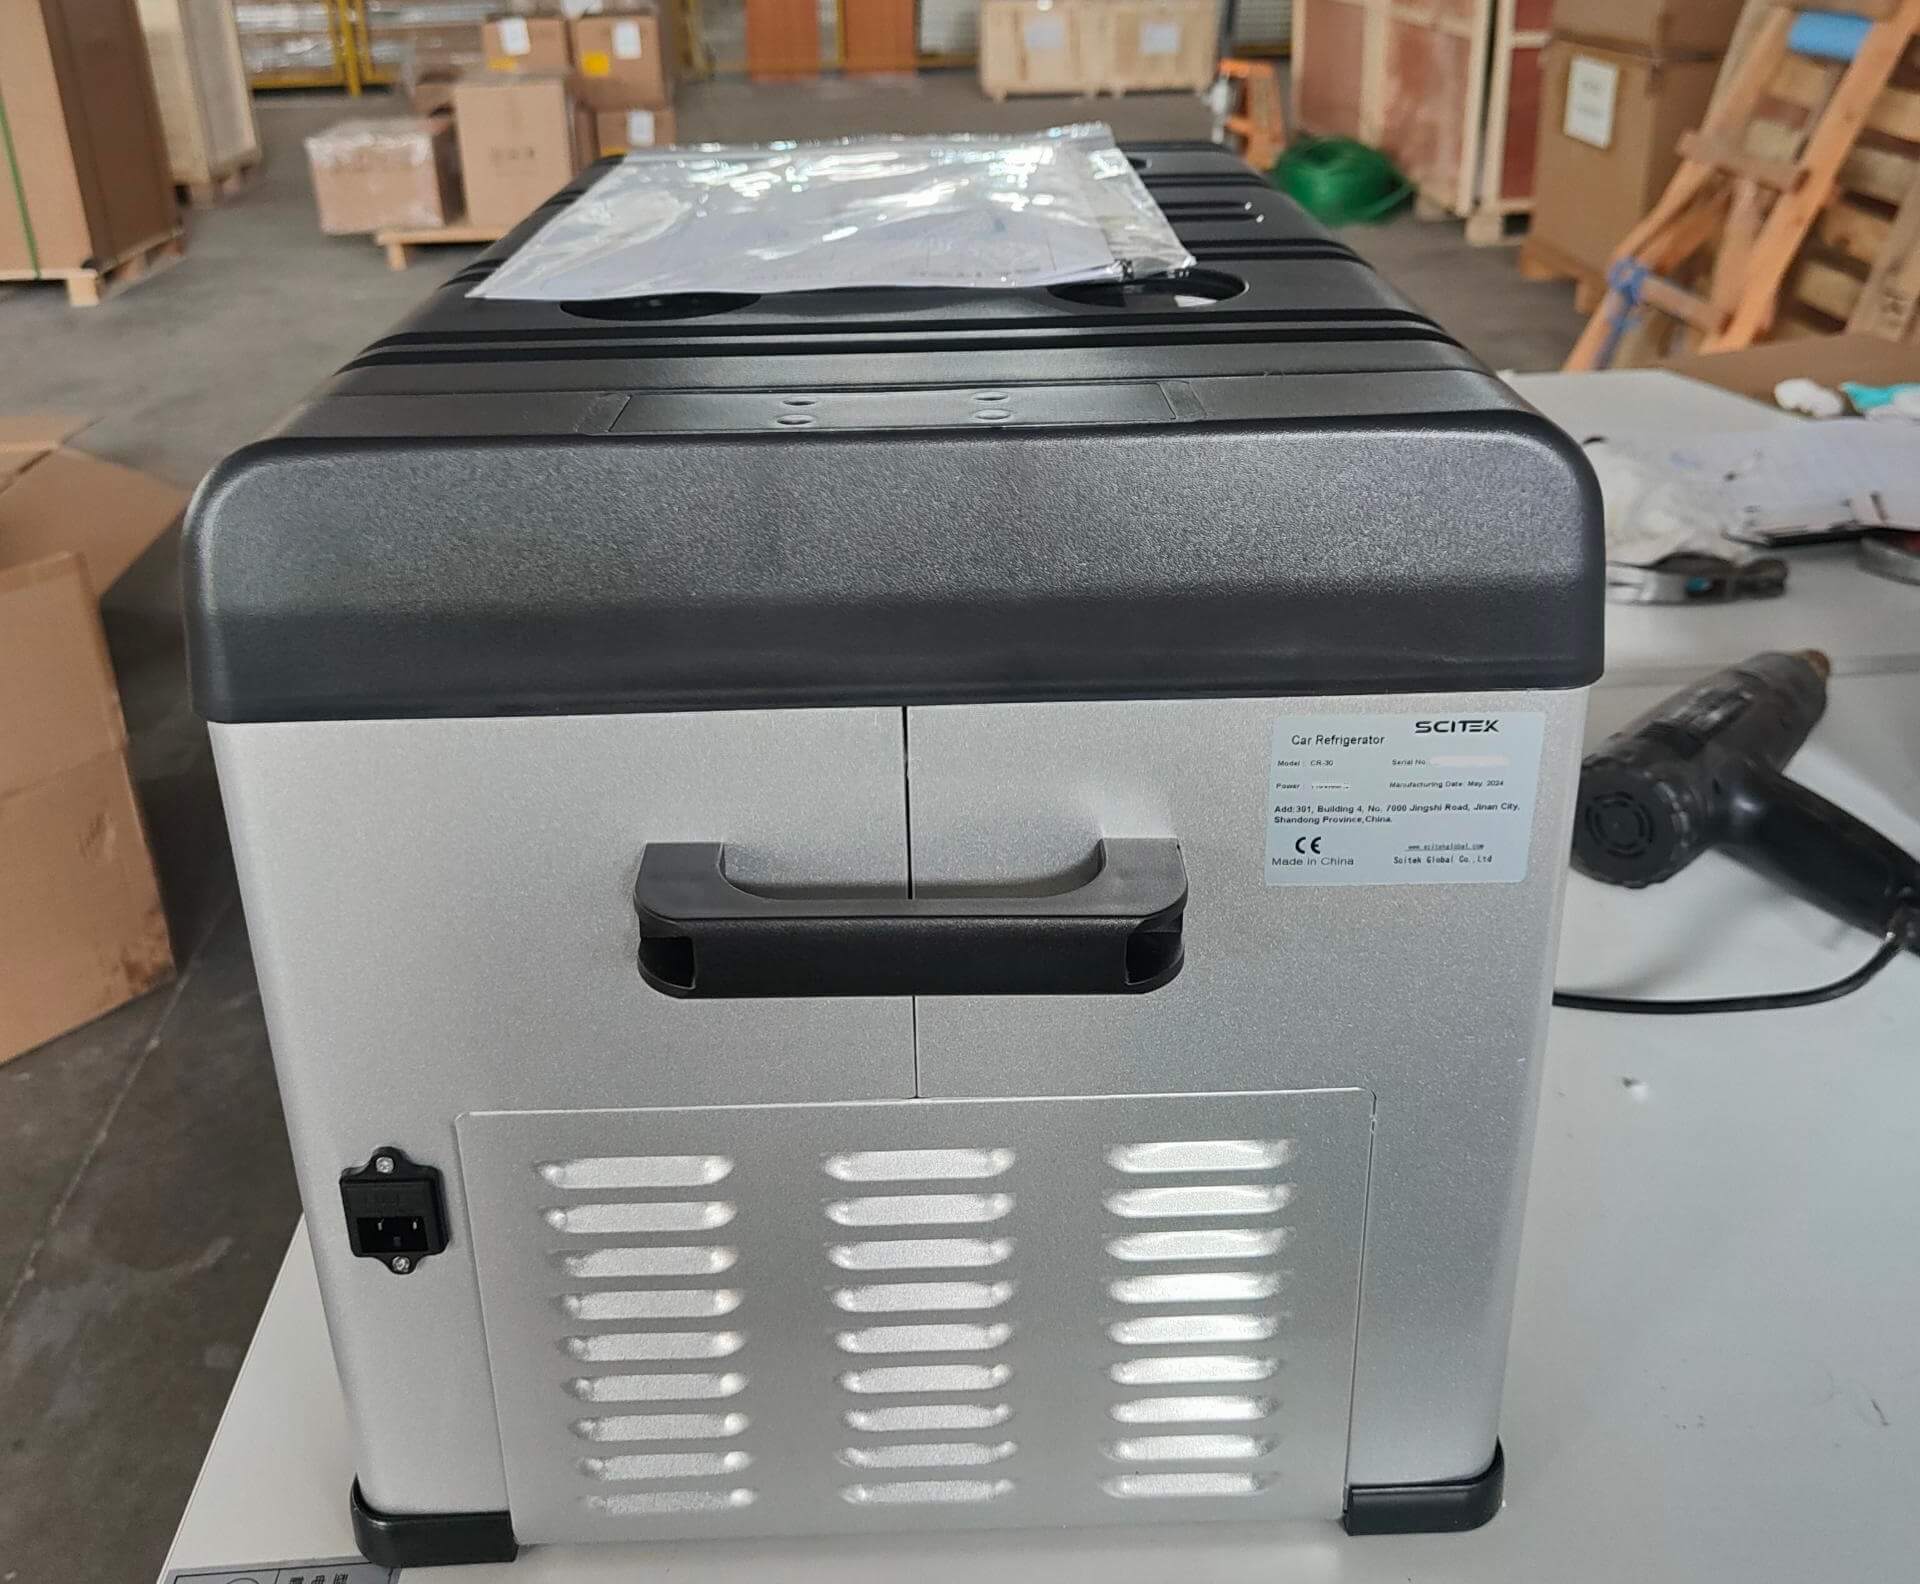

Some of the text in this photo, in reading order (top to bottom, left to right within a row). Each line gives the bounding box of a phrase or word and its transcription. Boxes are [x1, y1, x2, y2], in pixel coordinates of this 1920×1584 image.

[1415, 719, 1500, 734] SCITEK
[1291, 734, 1385, 748] Car Refrigerator
[1317, 804, 1354, 814] Building
[1409, 803, 1443, 813] Jingshi
[1473, 802, 1498, 811] Jinan
[1274, 816, 1320, 825] Shandong
[1272, 856, 1355, 866] Made in China
[1393, 855, 1422, 864] Scitek
[1426, 855, 1454, 864] Global
